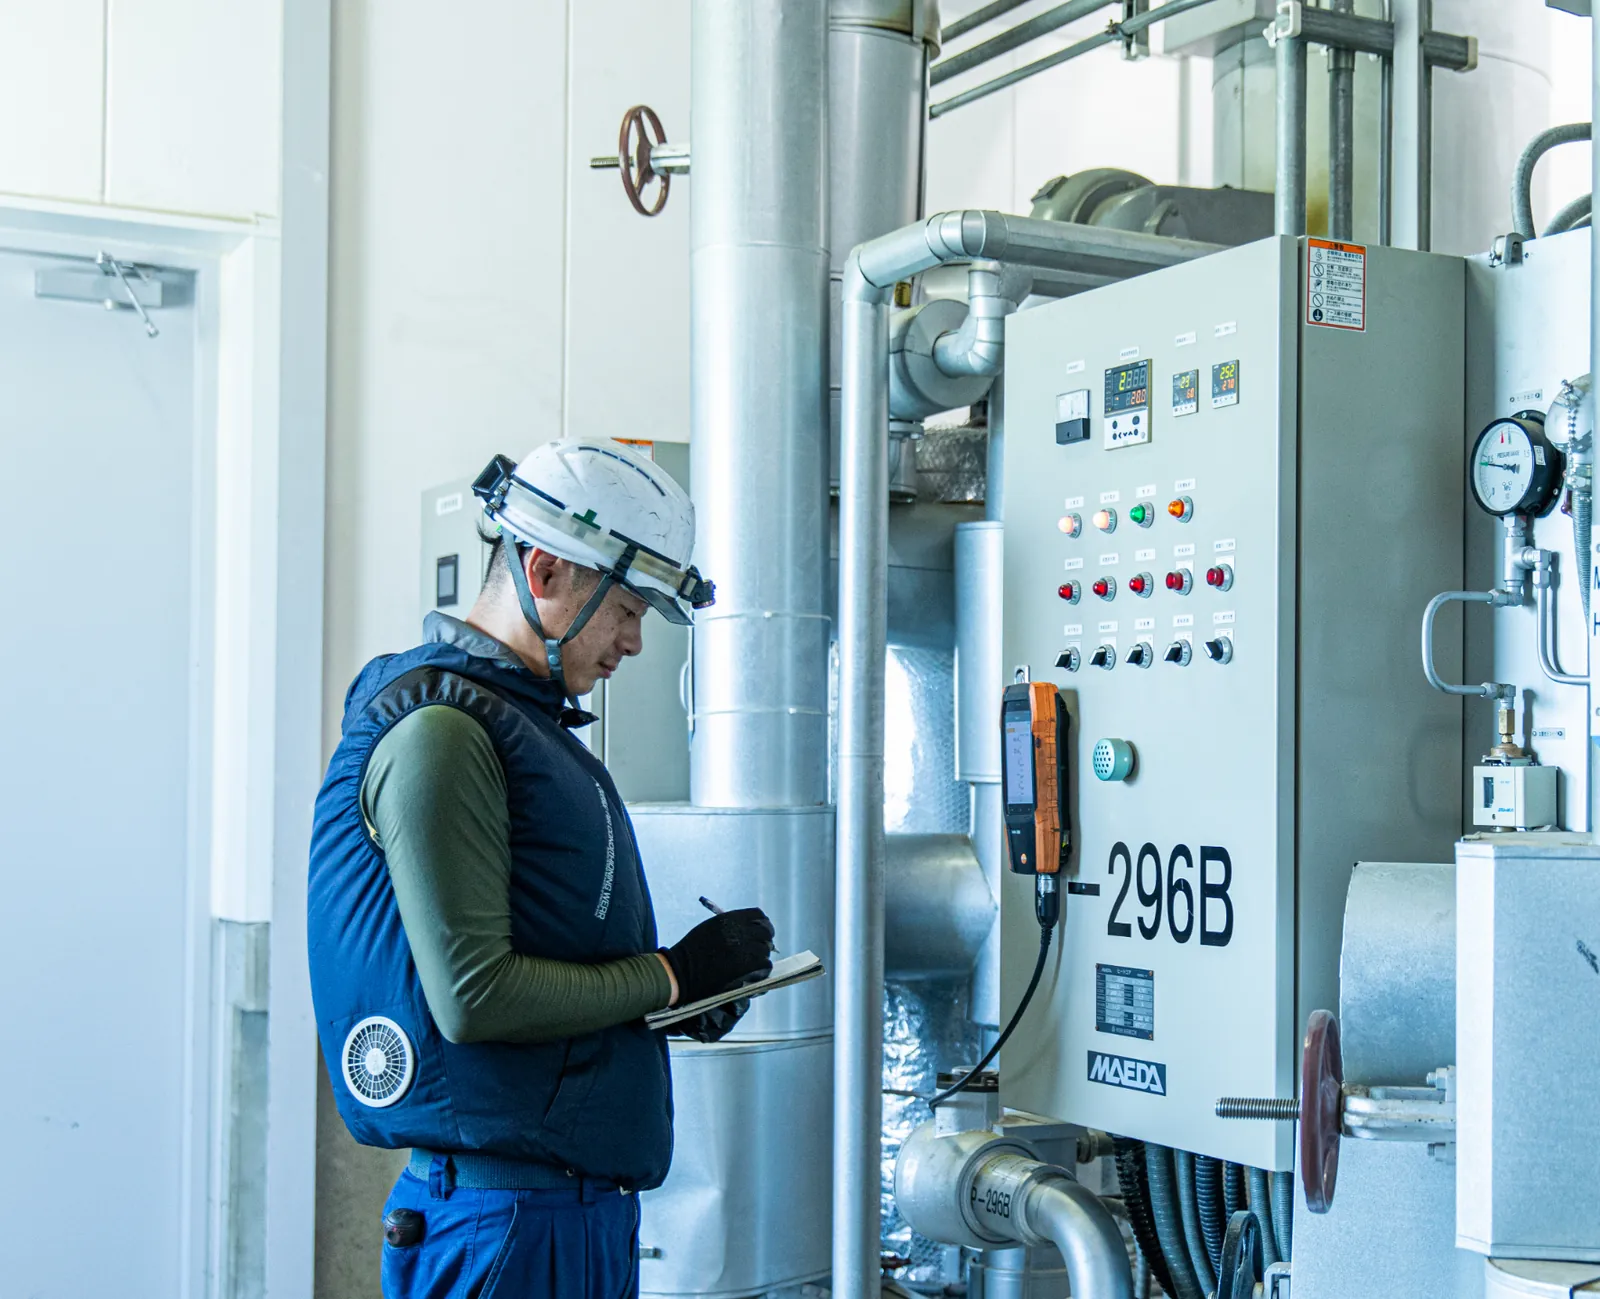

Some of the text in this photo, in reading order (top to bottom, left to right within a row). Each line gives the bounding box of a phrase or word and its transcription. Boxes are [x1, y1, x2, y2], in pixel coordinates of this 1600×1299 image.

[1219, 364, 1235, 380] 252
[599, 892, 611, 920] WEAR
[1089, 1054, 1164, 1093] MAEDA
[971, 1186, 1010, 1218] P-296B
